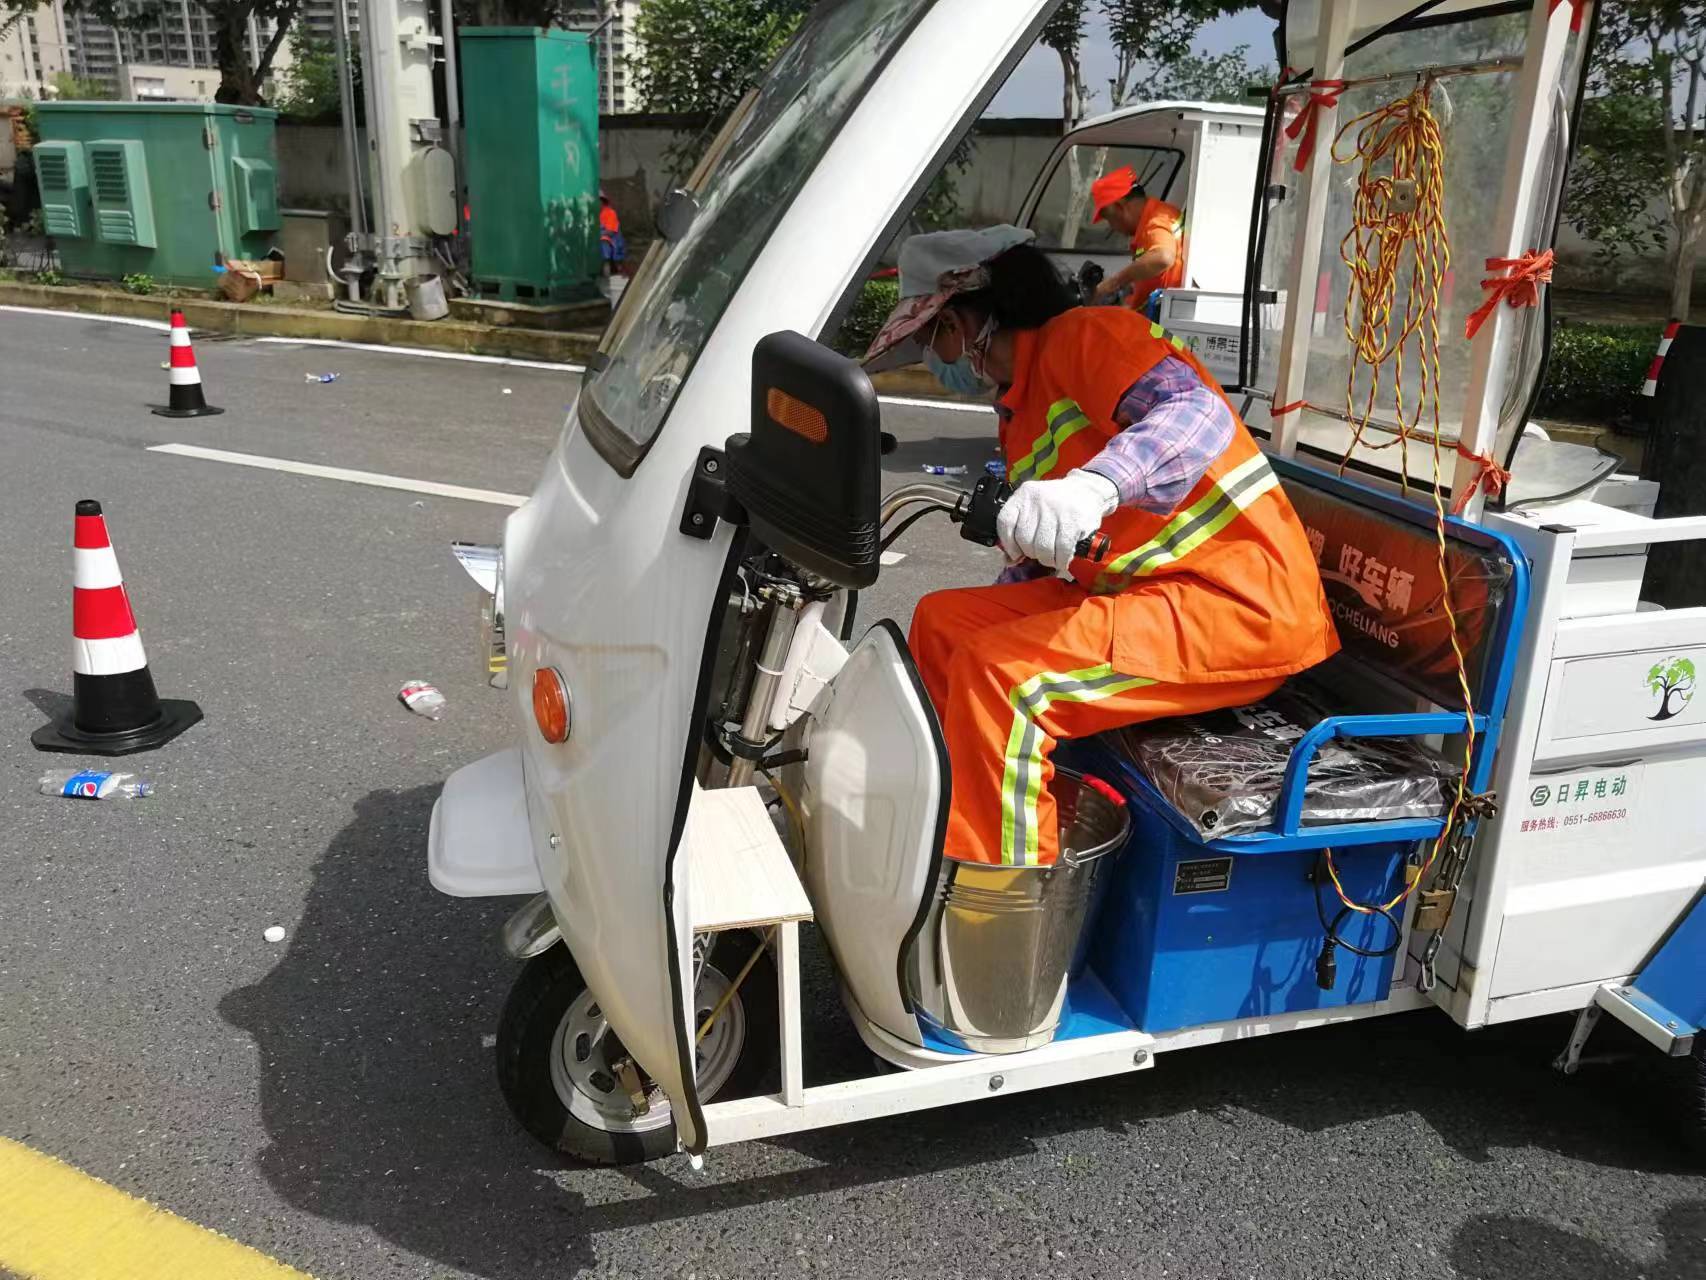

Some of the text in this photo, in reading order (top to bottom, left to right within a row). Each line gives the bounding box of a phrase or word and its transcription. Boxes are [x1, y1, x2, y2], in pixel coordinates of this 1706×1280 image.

[1338, 543, 1415, 617] 好车辆
[1557, 775, 1627, 803] 日昇电动
